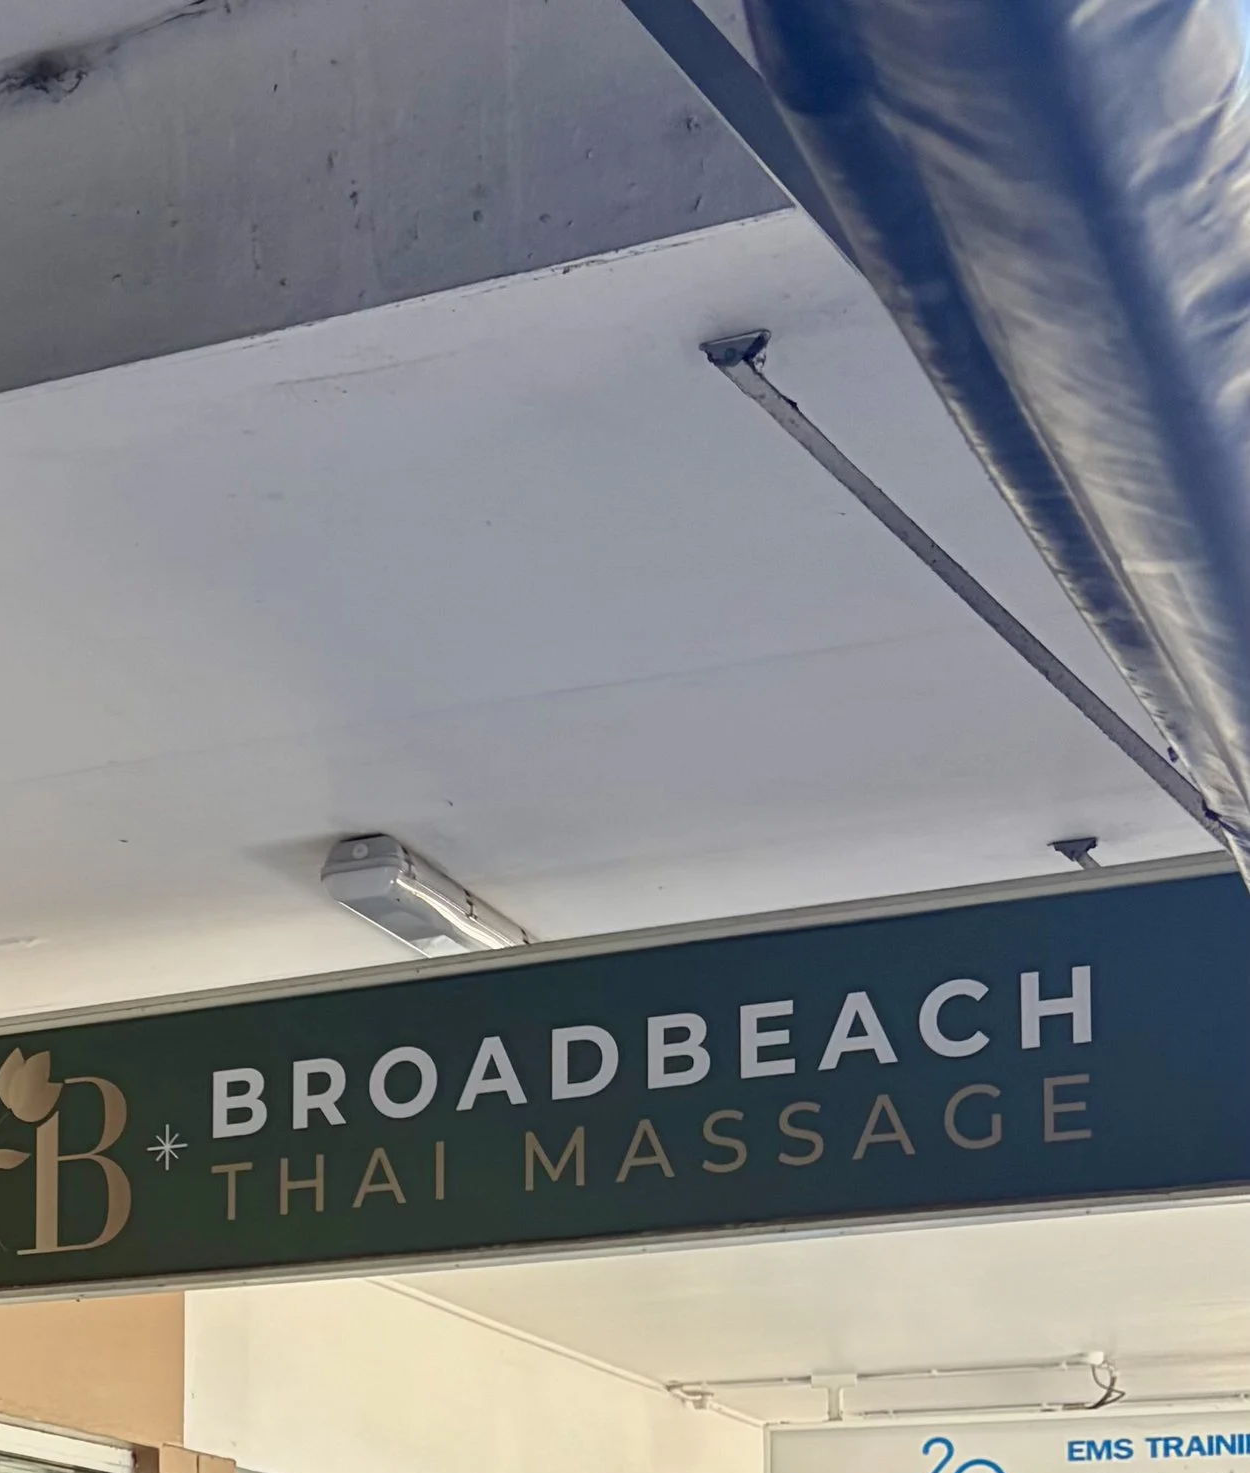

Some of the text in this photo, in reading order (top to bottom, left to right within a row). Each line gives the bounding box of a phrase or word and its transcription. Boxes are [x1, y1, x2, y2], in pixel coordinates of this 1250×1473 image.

[211, 964, 1093, 1139] BROADBEACH
[211, 1073, 1093, 1221] THAI MASSAGE
[1067, 1433, 1250, 1462] EMS TRAINI
